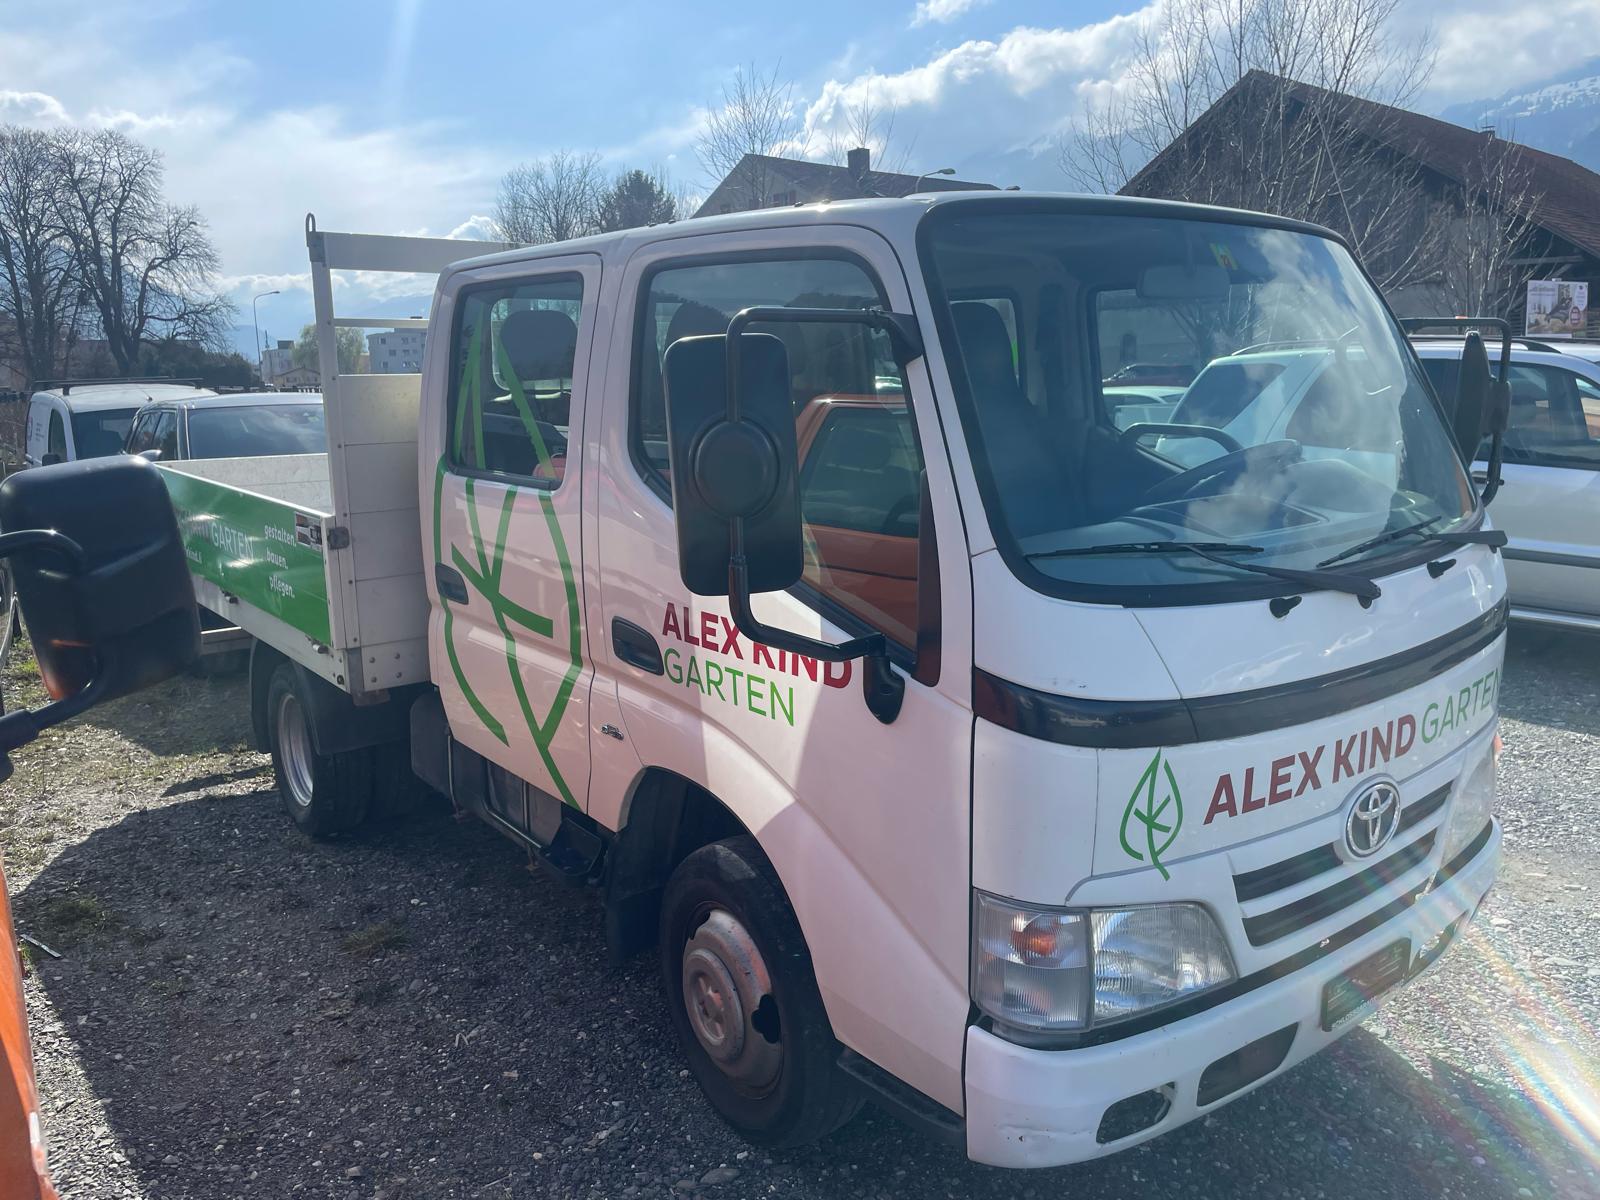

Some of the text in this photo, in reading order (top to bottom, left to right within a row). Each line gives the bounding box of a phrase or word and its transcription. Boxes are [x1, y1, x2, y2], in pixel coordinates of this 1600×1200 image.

[211, 521, 254, 561] GARTEN
[264, 524, 297, 547] gestalten.
[266, 546, 289, 570] bauen.
[268, 574, 295, 598] pflegen.
[662, 602, 744, 660] ALEX
[663, 647, 794, 727] GARTEN
[1203, 667, 1500, 826] ALEX KIND GARTEN
